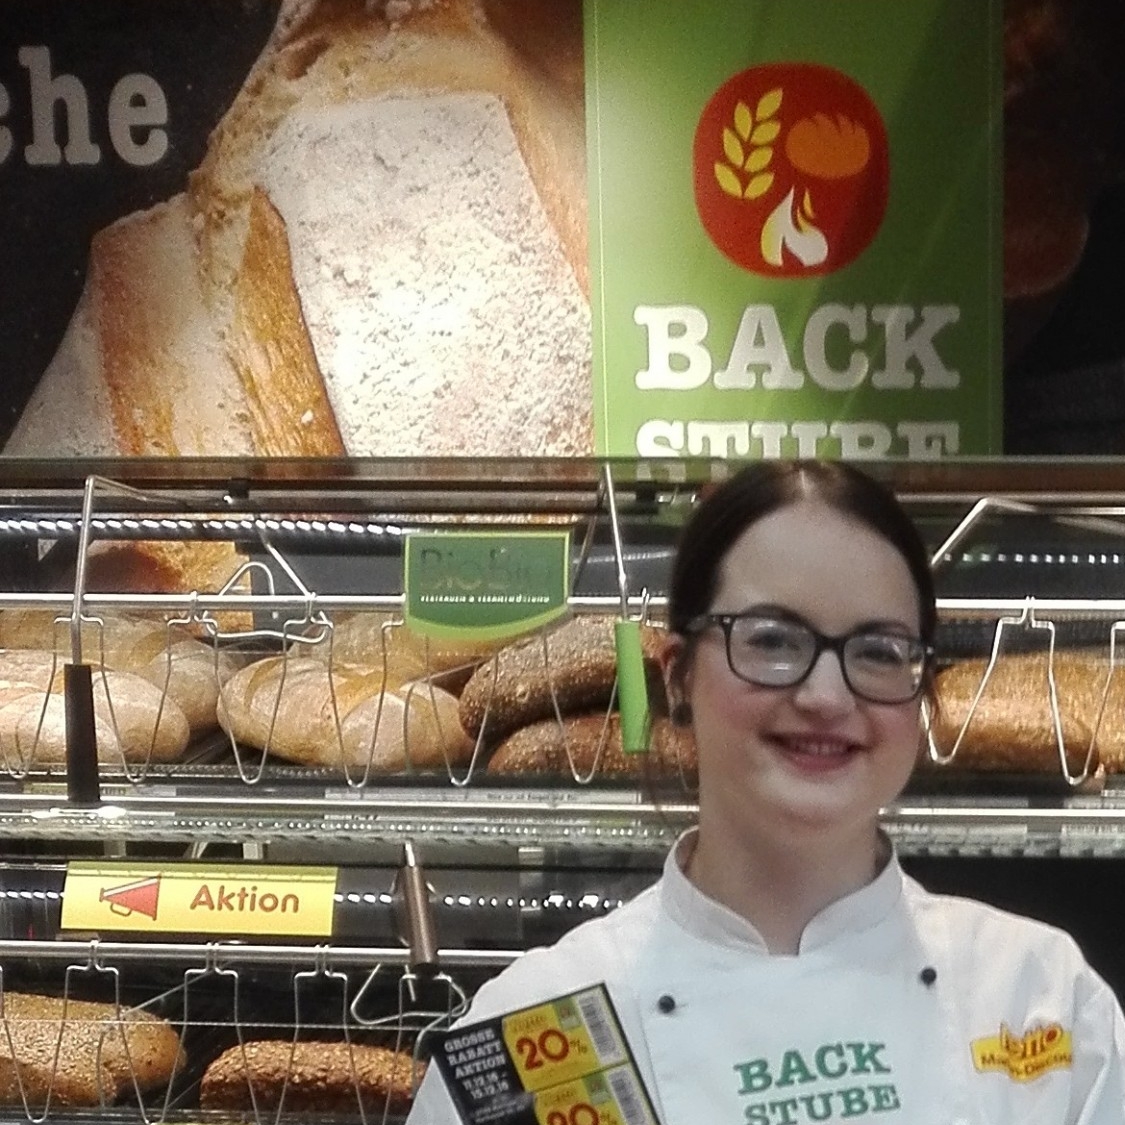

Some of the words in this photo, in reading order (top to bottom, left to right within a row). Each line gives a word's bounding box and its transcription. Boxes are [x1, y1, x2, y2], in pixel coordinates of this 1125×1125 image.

[0, 46, 168, 166] he
[633, 303, 961, 391] BACK
[189, 884, 299, 914] Aktion
[455, 1053, 506, 1080] AKTION
[732, 1040, 892, 1095] BACK
